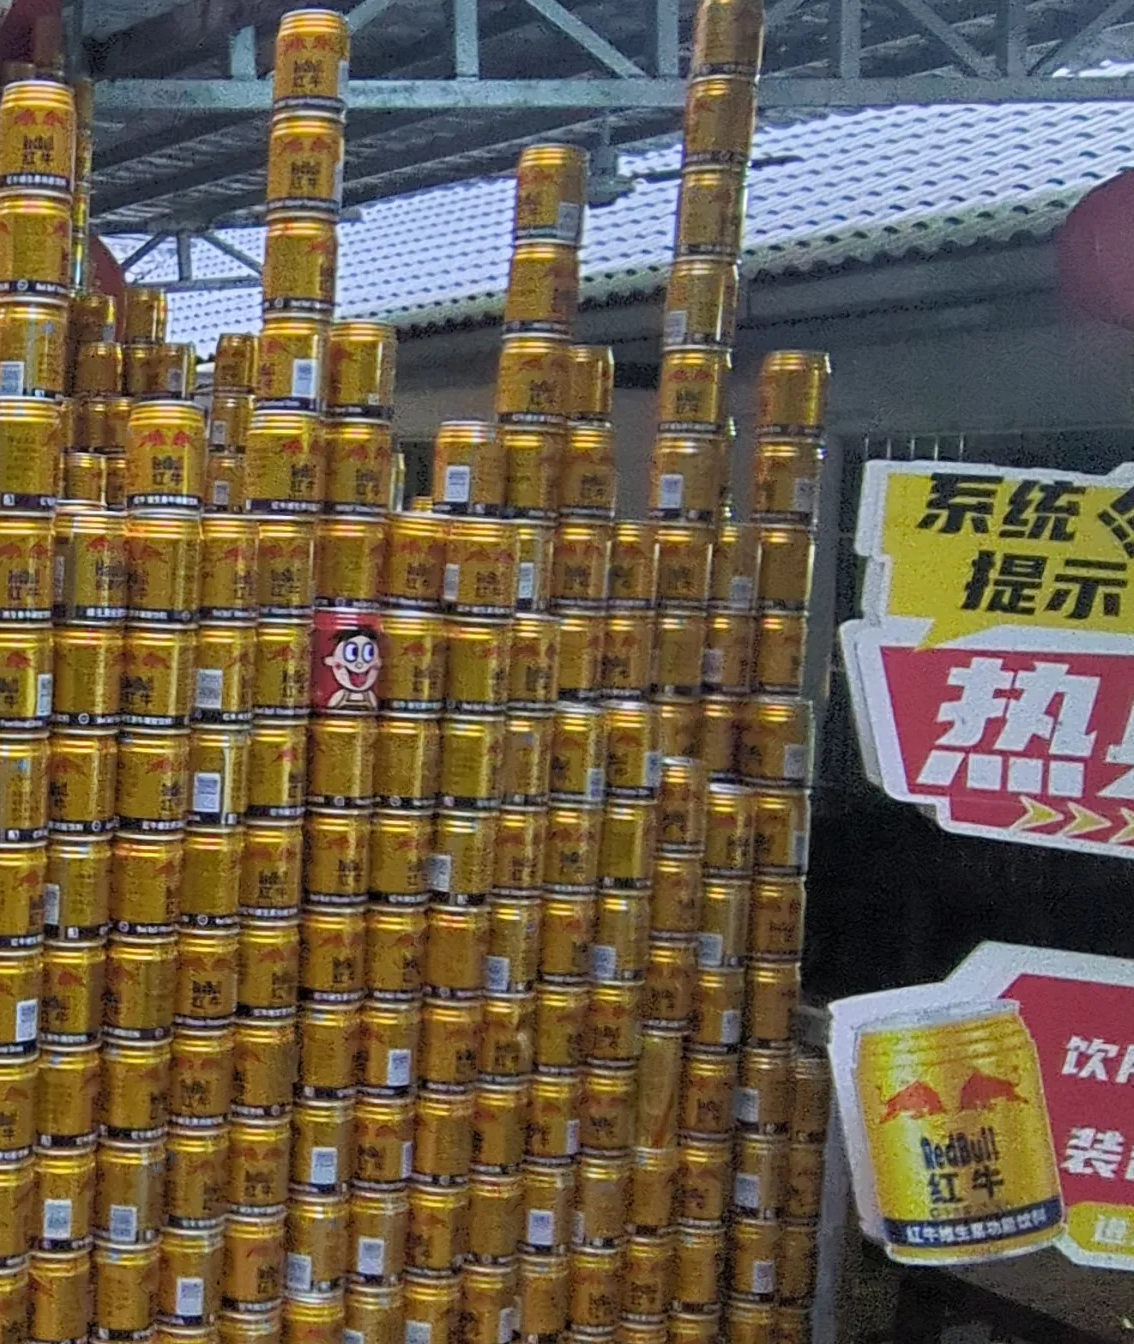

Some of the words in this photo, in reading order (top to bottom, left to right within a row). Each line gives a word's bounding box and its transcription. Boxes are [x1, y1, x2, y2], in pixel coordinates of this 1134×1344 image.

[918, 473, 1085, 542] 系统
[961, 550, 1128, 620] 提示
[928, 1165, 1004, 1204] 红牛
[1060, 1127, 1134, 1182] 装
